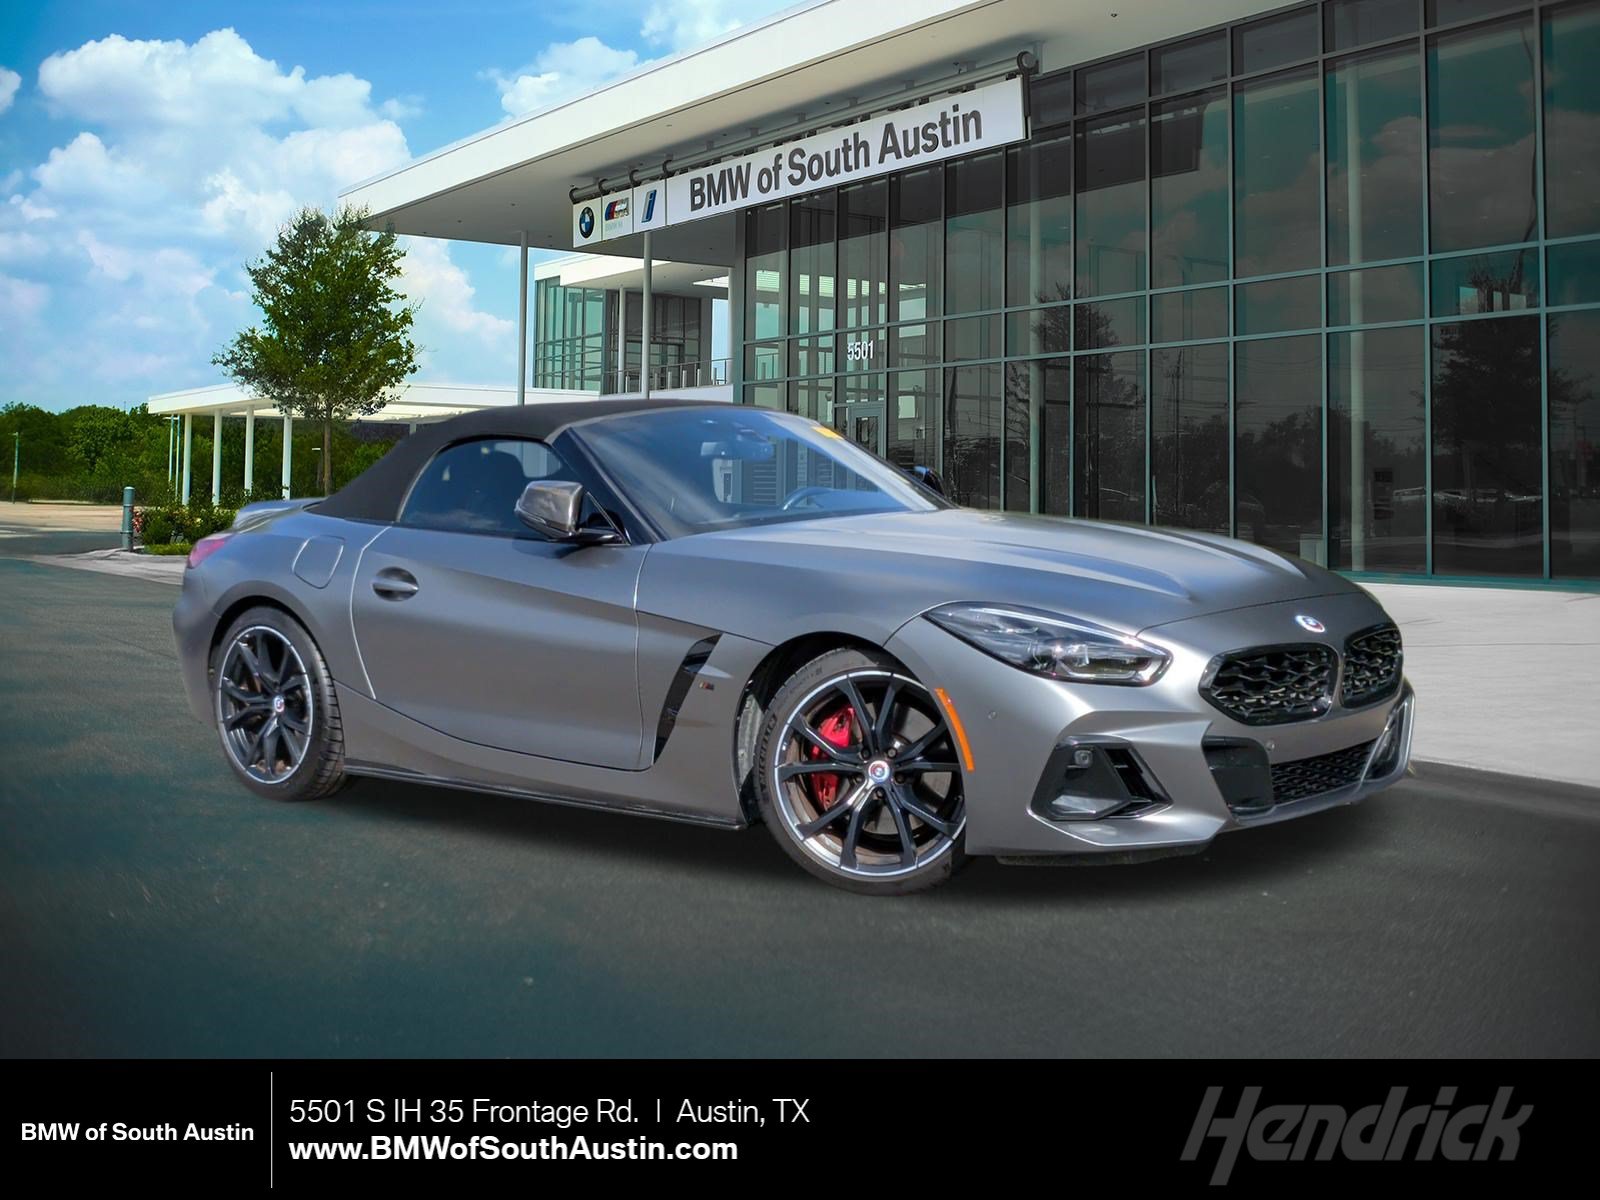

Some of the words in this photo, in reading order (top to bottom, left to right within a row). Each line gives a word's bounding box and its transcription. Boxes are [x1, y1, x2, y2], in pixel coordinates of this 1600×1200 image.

[690, 162, 752, 212] BMW
[757, 153, 783, 194] of
[787, 131, 871, 187] South
[878, 103, 983, 164] Austin
[847, 339, 874, 361] 5501
